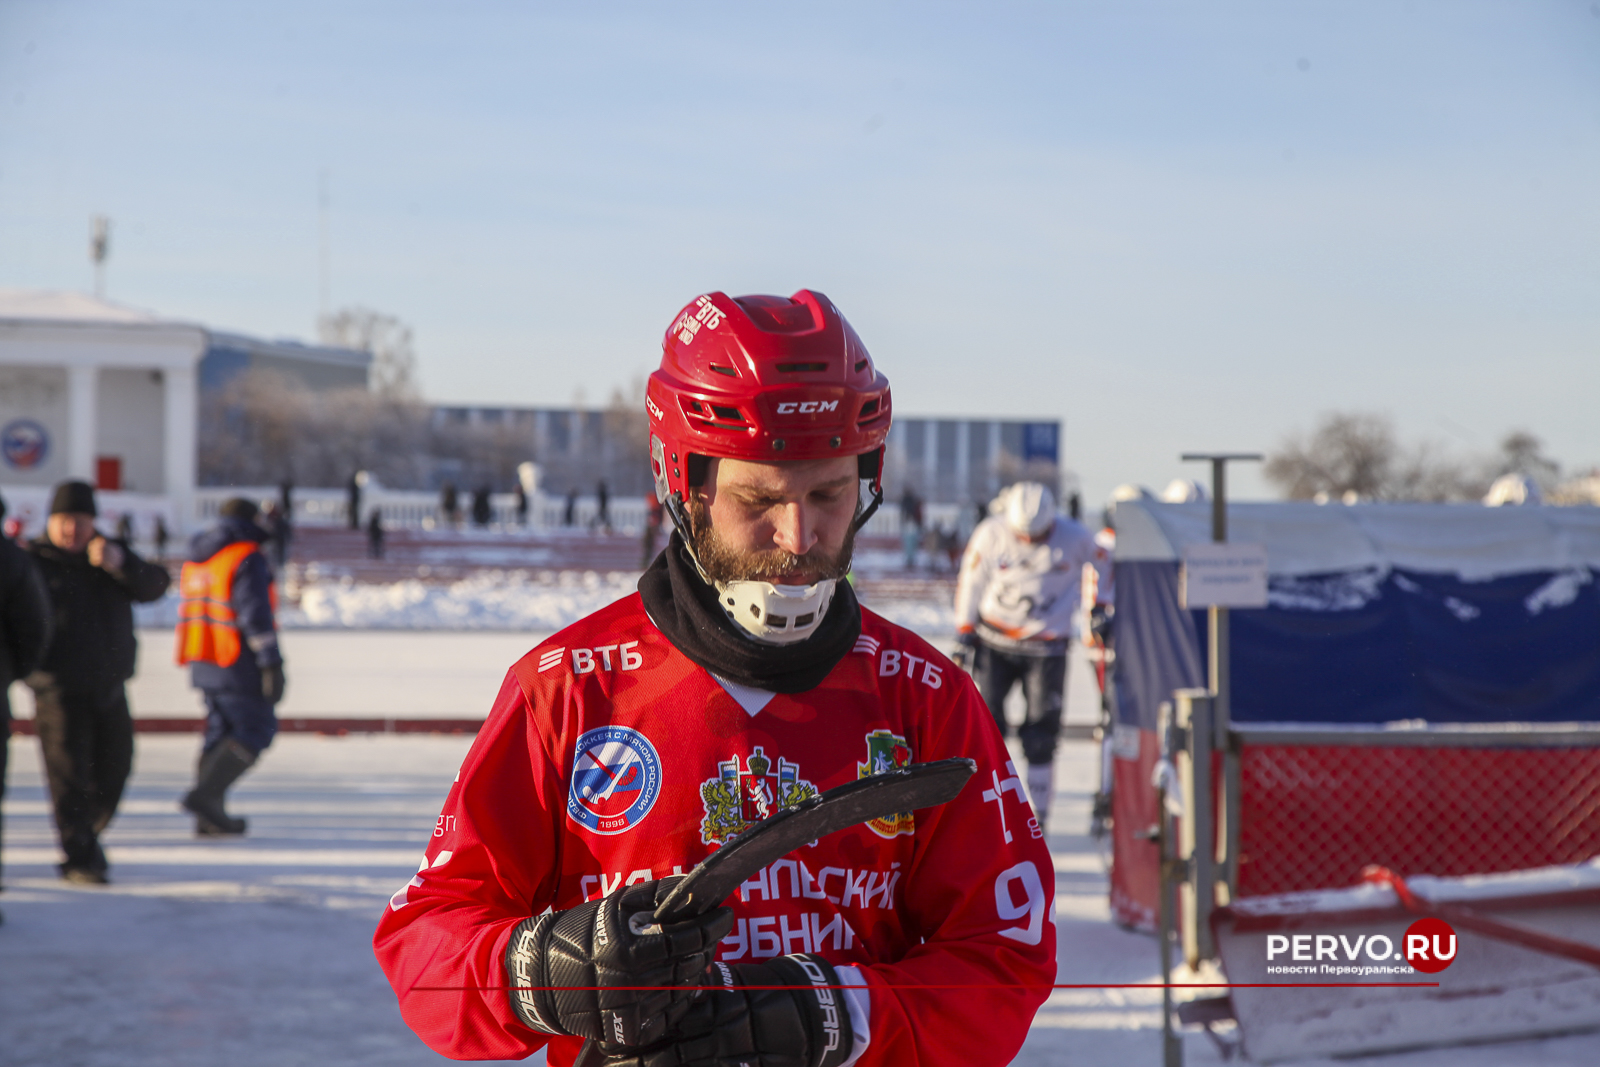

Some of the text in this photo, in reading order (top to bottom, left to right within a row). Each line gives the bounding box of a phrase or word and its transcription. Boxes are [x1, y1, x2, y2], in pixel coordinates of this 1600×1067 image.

[646, 396, 664, 421] CCM
[776, 400, 839, 414] CCM
[571, 640, 643, 675] ВТБ
[879, 649, 943, 690] ВТБ
[622, 733, 653, 764] МЯЧОМ
[637, 765, 656, 811] РОССИИ
[600, 818, 625, 828] 1898
